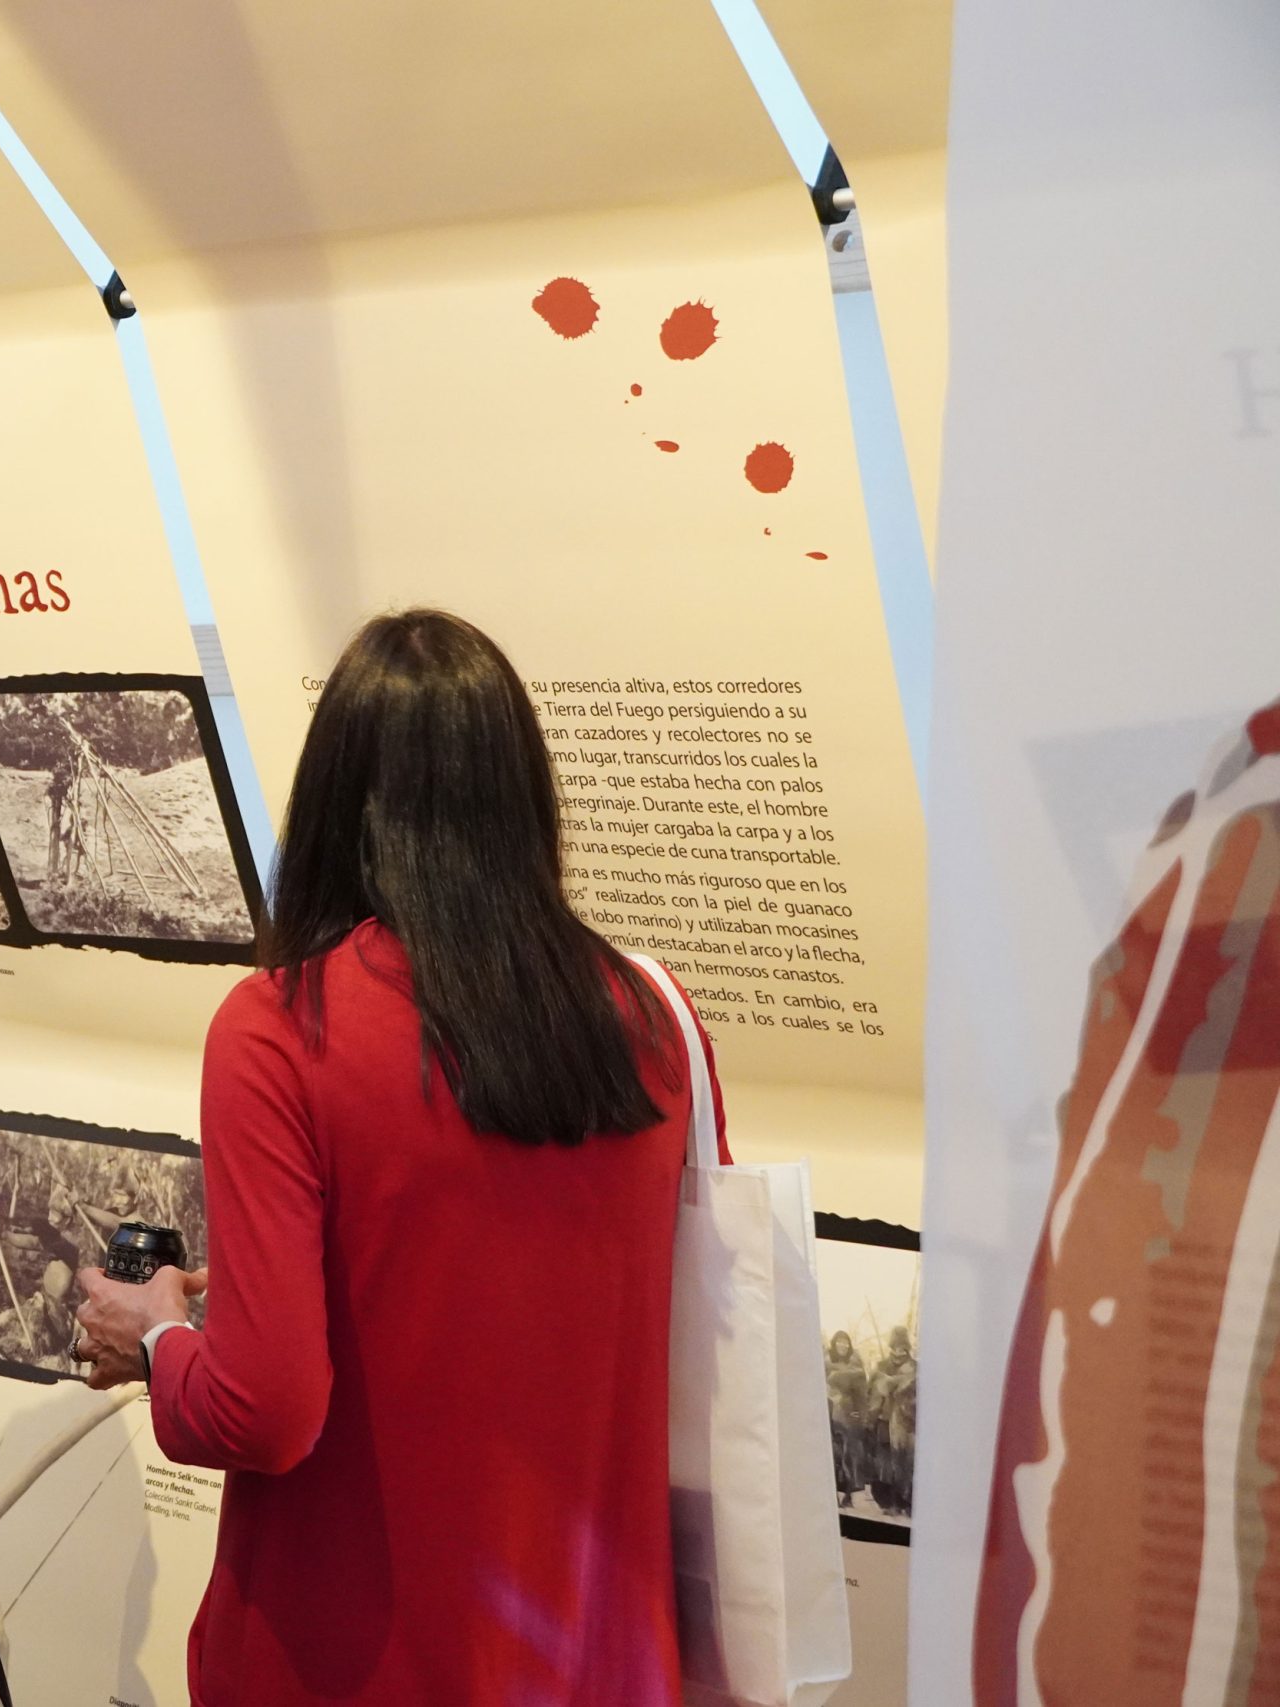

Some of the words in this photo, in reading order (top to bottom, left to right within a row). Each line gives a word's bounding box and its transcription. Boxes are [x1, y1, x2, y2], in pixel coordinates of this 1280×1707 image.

[531, 681, 547, 692] su
[552, 678, 621, 696] presencia
[625, 677, 670, 695] altiva,
[673, 680, 712, 694] estos
[717, 677, 802, 694] corredores
[544, 702, 586, 716] Tierra
[590, 701, 613, 717] del
[616, 702, 664, 722] Fuego
[668, 702, 770, 722] persiguiendo
[775, 706, 784, 718] a
[788, 706, 807, 718] su
[574, 725, 648, 741] cazadores
[652, 730, 662, 745] y
[668, 726, 762, 743] recolectores
[767, 731, 788, 744] no
[794, 731, 812, 744] se
[580, 747, 621, 768] lugar,
[624, 750, 722, 766] transcurridos
[724, 750, 747, 767] los
[750, 752, 800, 768] cuales
[803, 752, 818, 768] la
[601, 775, 636, 790] -que
[640, 774, 690, 790] estaba
[694, 774, 741, 790] hecha
[746, 779, 776, 792] con
[780, 776, 824, 796] palos
[642, 796, 704, 813] Durante
[708, 800, 744, 816] este,
[747, 800, 760, 815] el
[764, 800, 828, 818] hombre
[590, 817, 604, 832] la
[607, 819, 649, 838] mujer
[654, 820, 714, 840] cargaba
[718, 822, 732, 838] la
[736, 826, 779, 842] carpa
[783, 828, 792, 844] y
[798, 829, 807, 840] a
[810, 825, 834, 842] los
[582, 842, 609, 854] una
[611, 842, 666, 859] especie
[668, 844, 688, 858] de
[691, 848, 728, 860] cuna
[730, 847, 841, 866] transportable.
[592, 868, 608, 880] es
[610, 868, 662, 884] mucho
[664, 870, 696, 886] más
[699, 872, 762, 891] riguroso
[766, 878, 796, 894] que
[800, 880, 820, 892] en
[823, 878, 847, 894] los
[595, 888, 666, 906] realizados
[672, 896, 700, 908] con
[704, 894, 718, 910] la
[724, 896, 752, 914] piel
[758, 898, 778, 912] de
[784, 902, 853, 918] guanaco
[590, 908, 624, 924] lobo
[628, 914, 682, 931] marino)
[686, 920, 694, 934] y
[699, 917, 772, 935] utilizaban
[776, 924, 858, 940] mocasines
[604, 932, 645, 948] omún
[648, 934, 732, 955] destacaban
[734, 941, 747, 956] el
[750, 946, 782, 958] arco
[784, 948, 794, 962] y
[796, 944, 810, 960] la
[813, 946, 866, 966] flecha,
[660, 957, 692, 972] ban
[694, 960, 770, 979] hermosos
[773, 968, 844, 985] canastos.
[755, 990, 775, 1005] En
[784, 994, 846, 1012] cambio,
[853, 1001, 878, 1014] era
[697, 1006, 730, 1022] bios
[737, 1013, 746, 1024] a
[752, 1010, 775, 1026] los
[782, 1016, 830, 1031] cuales
[836, 1020, 854, 1034] se
[860, 1020, 884, 1036] los
[146, 1464, 176, 1478] Hombres
[210, 1480, 222, 1490] con
[146, 1478, 164, 1488] arcos
[164, 1482, 170, 1491] y
[170, 1482, 196, 1496] flechas.
[144, 1488, 174, 1504] Colección
[175, 1496, 192, 1509] Sankt
